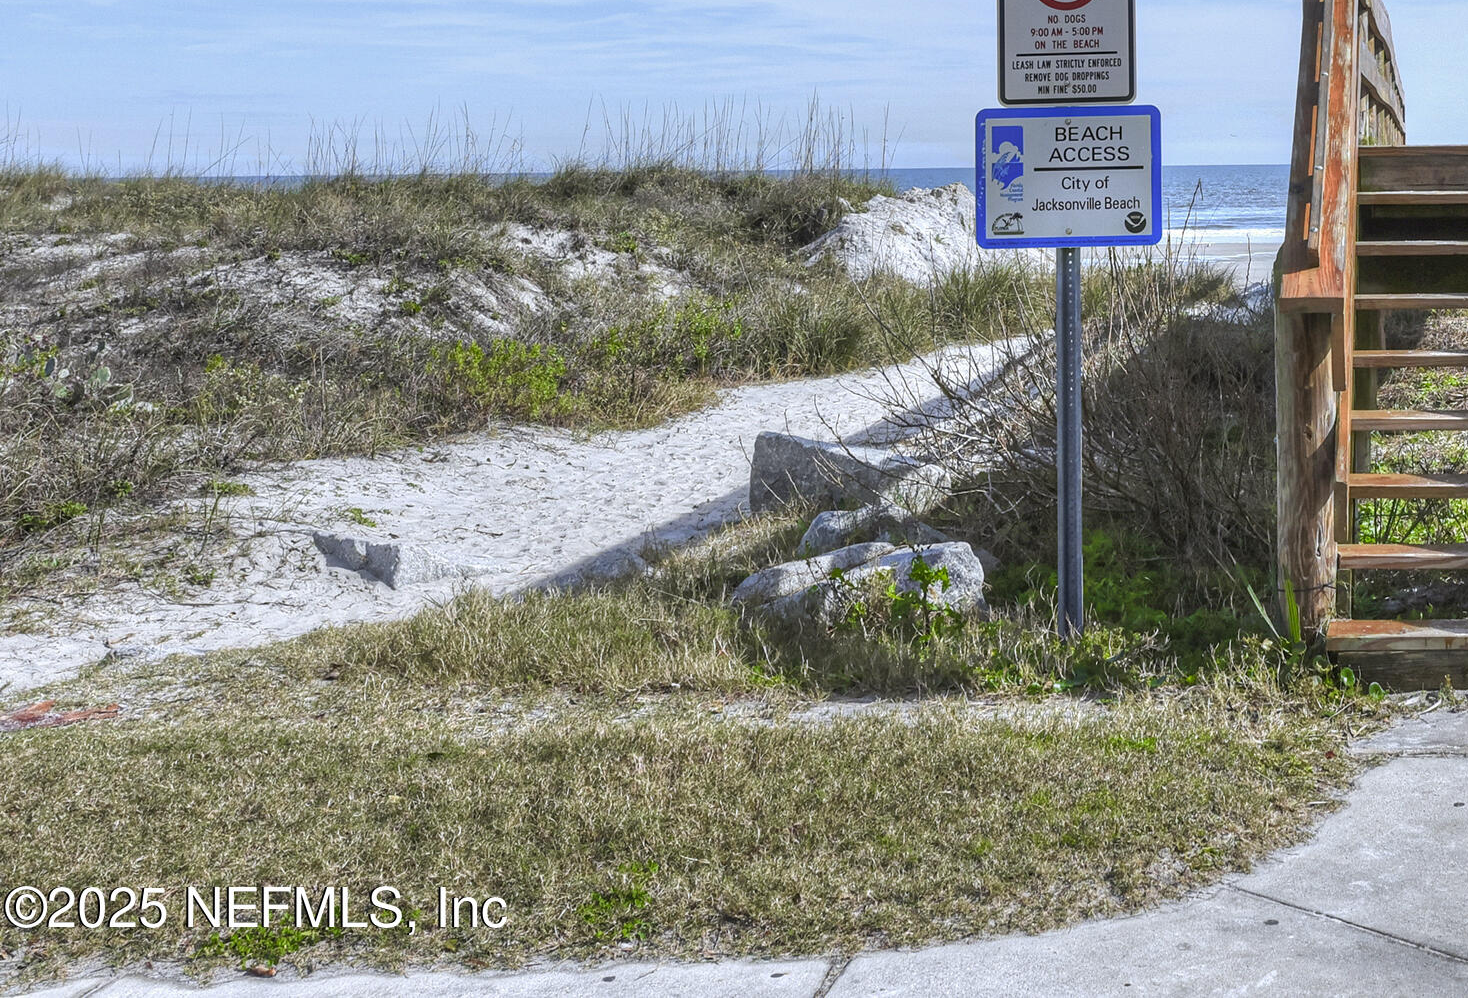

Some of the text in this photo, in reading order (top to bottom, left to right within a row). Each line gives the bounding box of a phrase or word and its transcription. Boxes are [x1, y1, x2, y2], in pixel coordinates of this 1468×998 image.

[1048, 14, 1086, 24] NO DOGS
[1031, 28, 1049, 37] 9:00
[1051, 28, 1062, 36] AM
[1072, 27, 1090, 35] 5:00
[1092, 27, 1103, 35] PM
[1035, 40, 1100, 50] ON THE BEACH
[1012, 58, 1121, 70] LEASH LAW STRICTLY ENFORCED
[1025, 71, 1109, 82] REMOVE DOG DROPPINGS
[1038, 84, 1097, 94] MIN FINE $50.00
[1055, 125, 1122, 142] BEACH
[1048, 146, 1130, 163] ACCESS
[1061, 176, 1109, 192] City of
[1032, 196, 1140, 211] Jacksonville Beach
